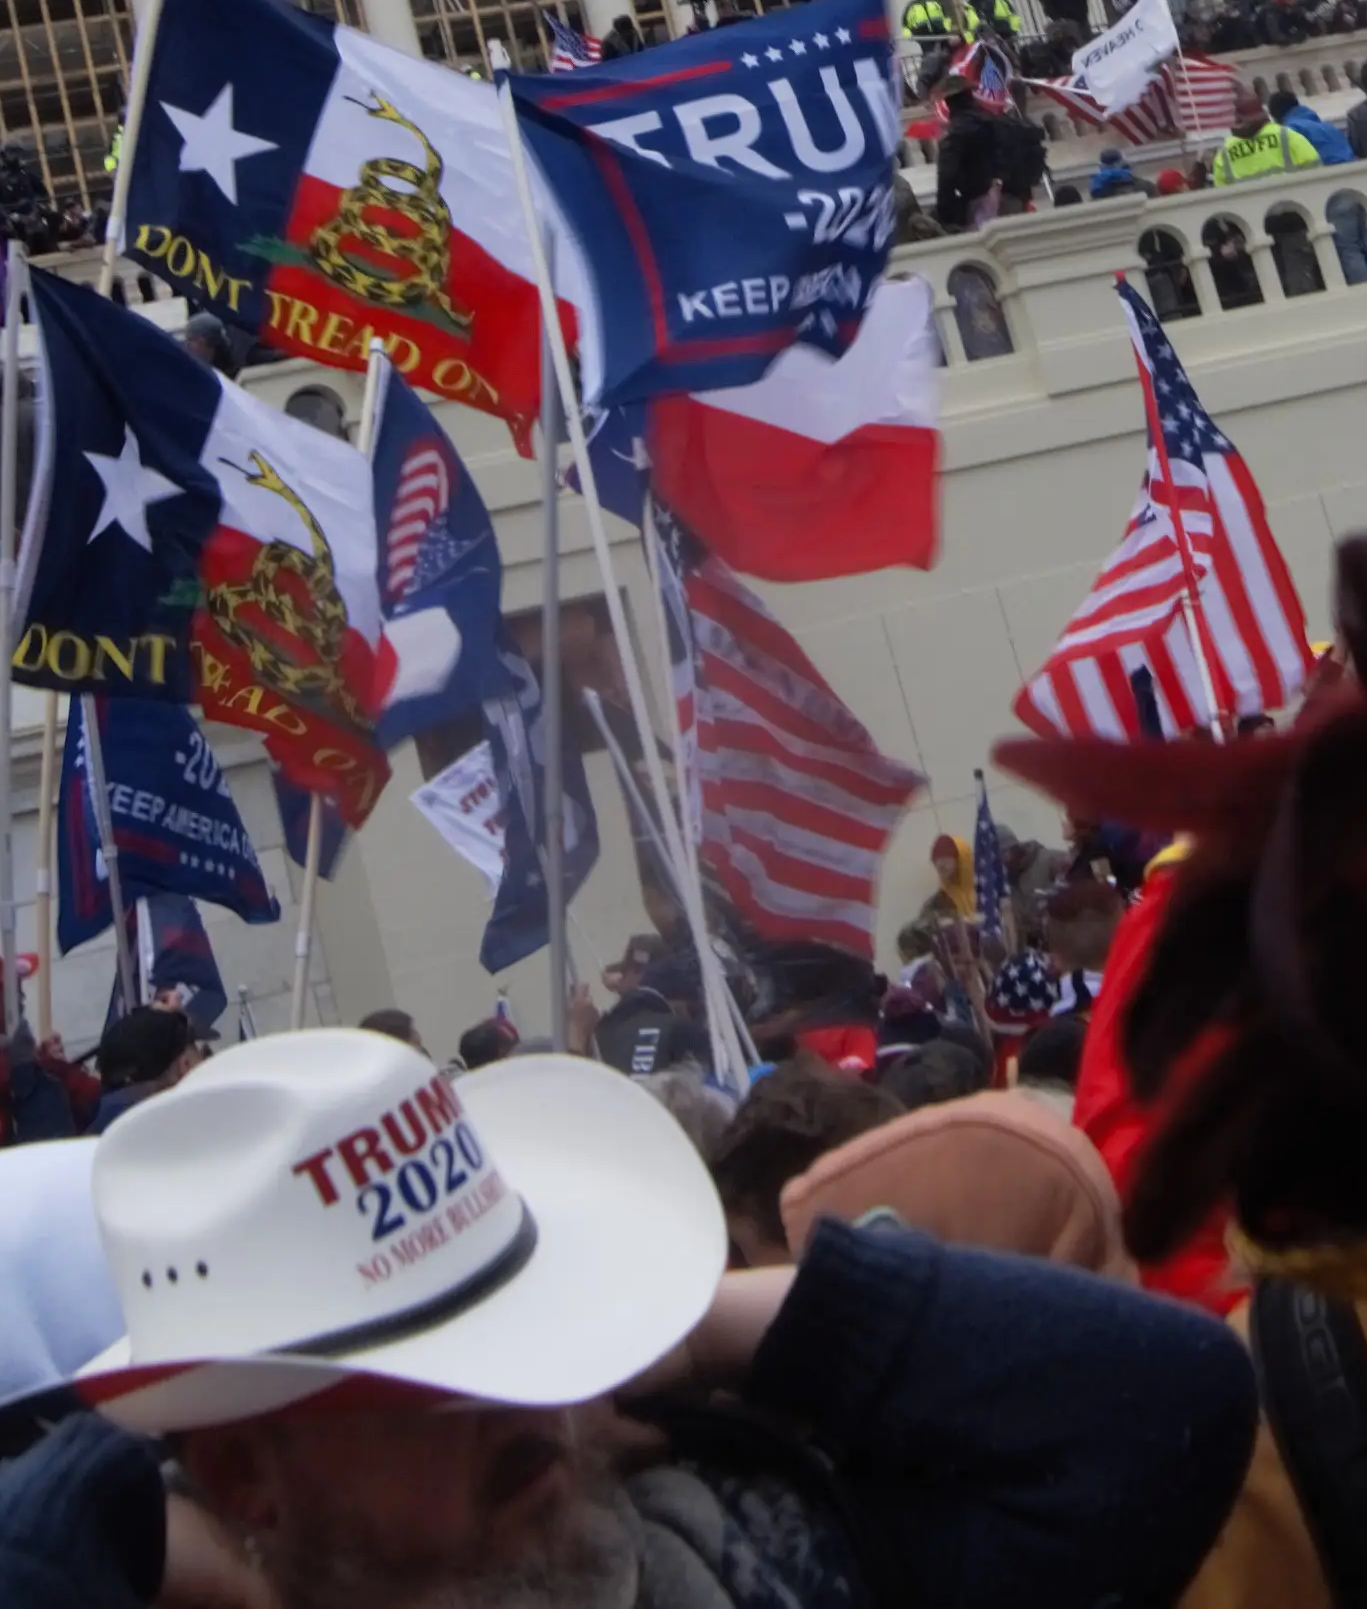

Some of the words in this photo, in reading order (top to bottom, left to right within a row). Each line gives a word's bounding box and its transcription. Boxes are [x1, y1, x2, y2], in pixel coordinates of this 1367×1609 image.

[134, 223, 254, 314] DONT
[265, 288, 422, 375] TREAD
[677, 275, 791, 323] KEEP
[11, 621, 178, 685] DONT
[162, 802, 240, 859] AMERICA
[355, 1121, 484, 1243] 2020
